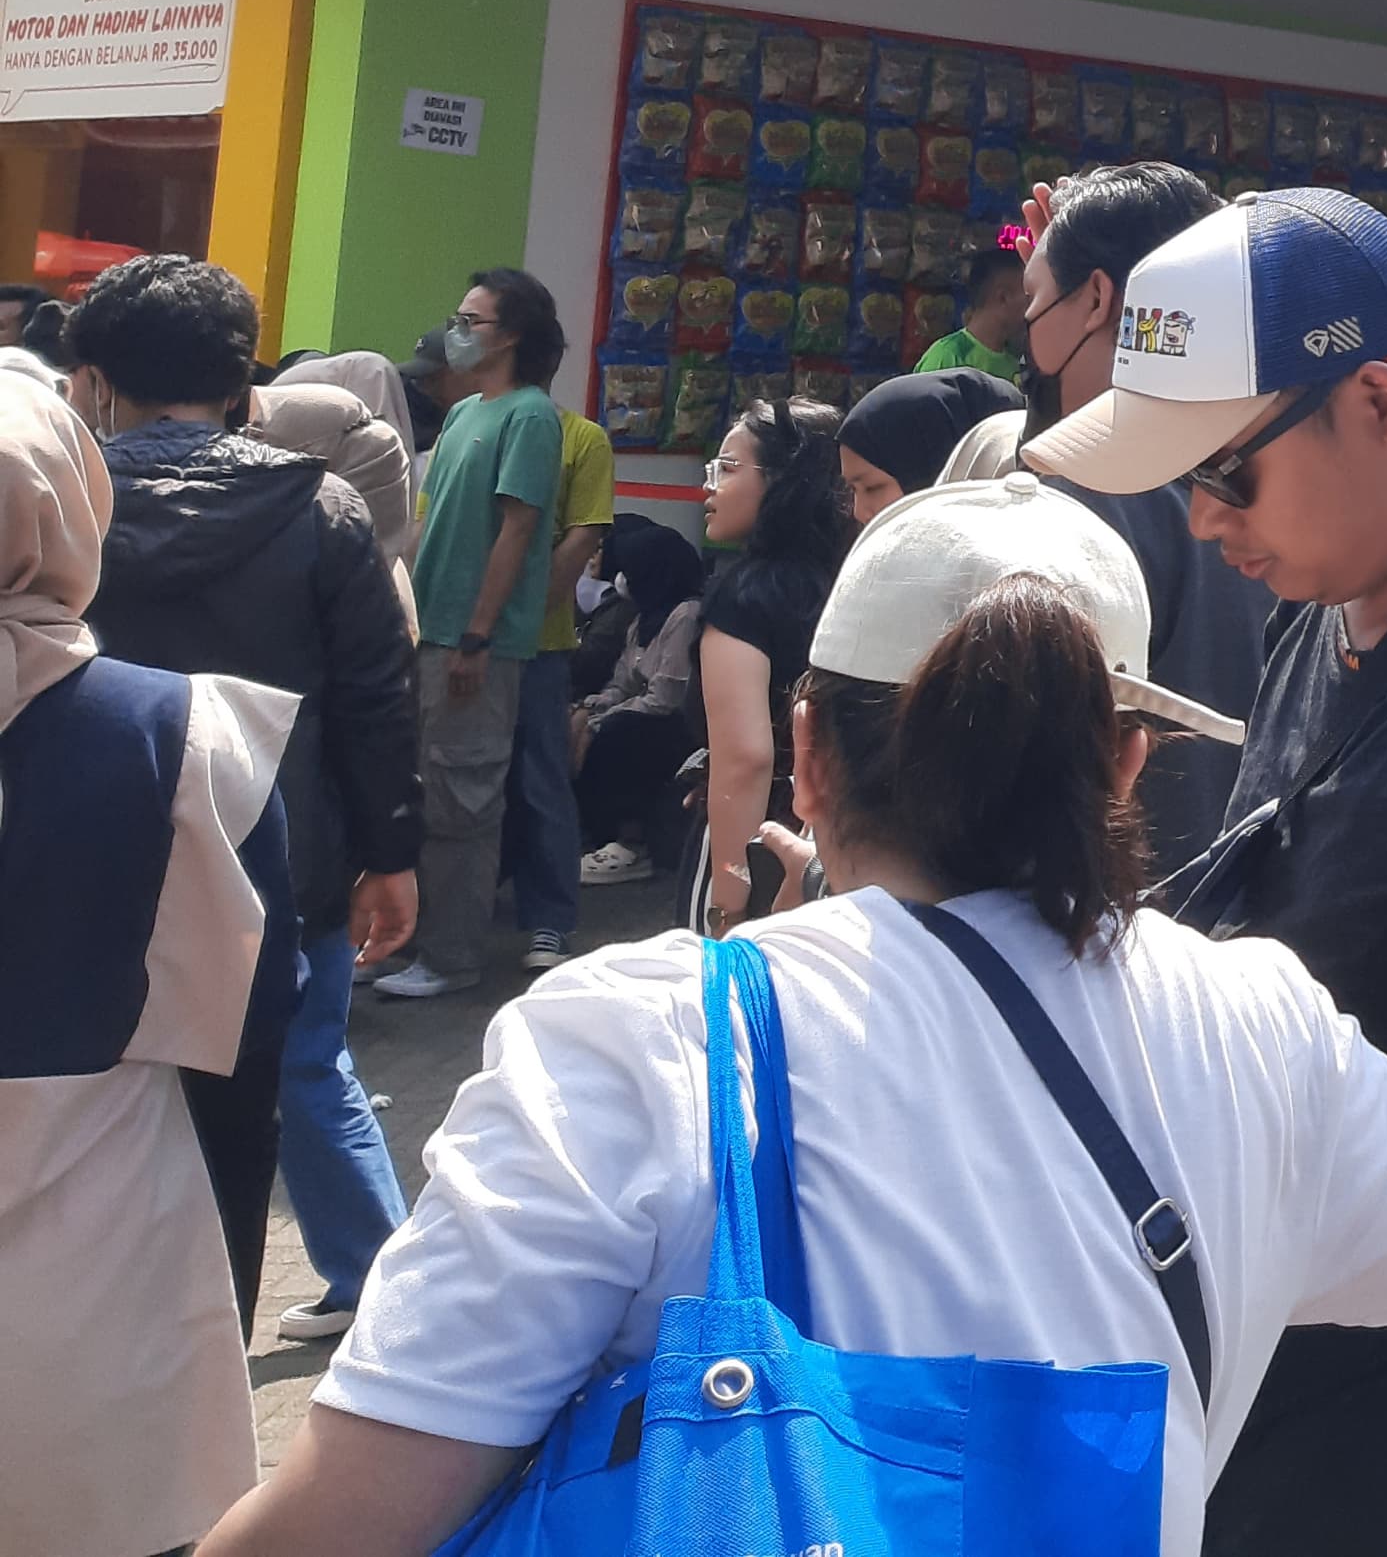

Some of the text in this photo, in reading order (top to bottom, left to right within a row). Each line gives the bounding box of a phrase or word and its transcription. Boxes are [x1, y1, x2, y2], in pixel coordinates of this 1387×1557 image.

[6, 3, 224, 41] MOTOR DAN HADIAH LAINNYA
[5, 39, 218, 71] HANYA DENGAN BELANJA RP. 35.000
[428, 127, 468, 147] CCTV
